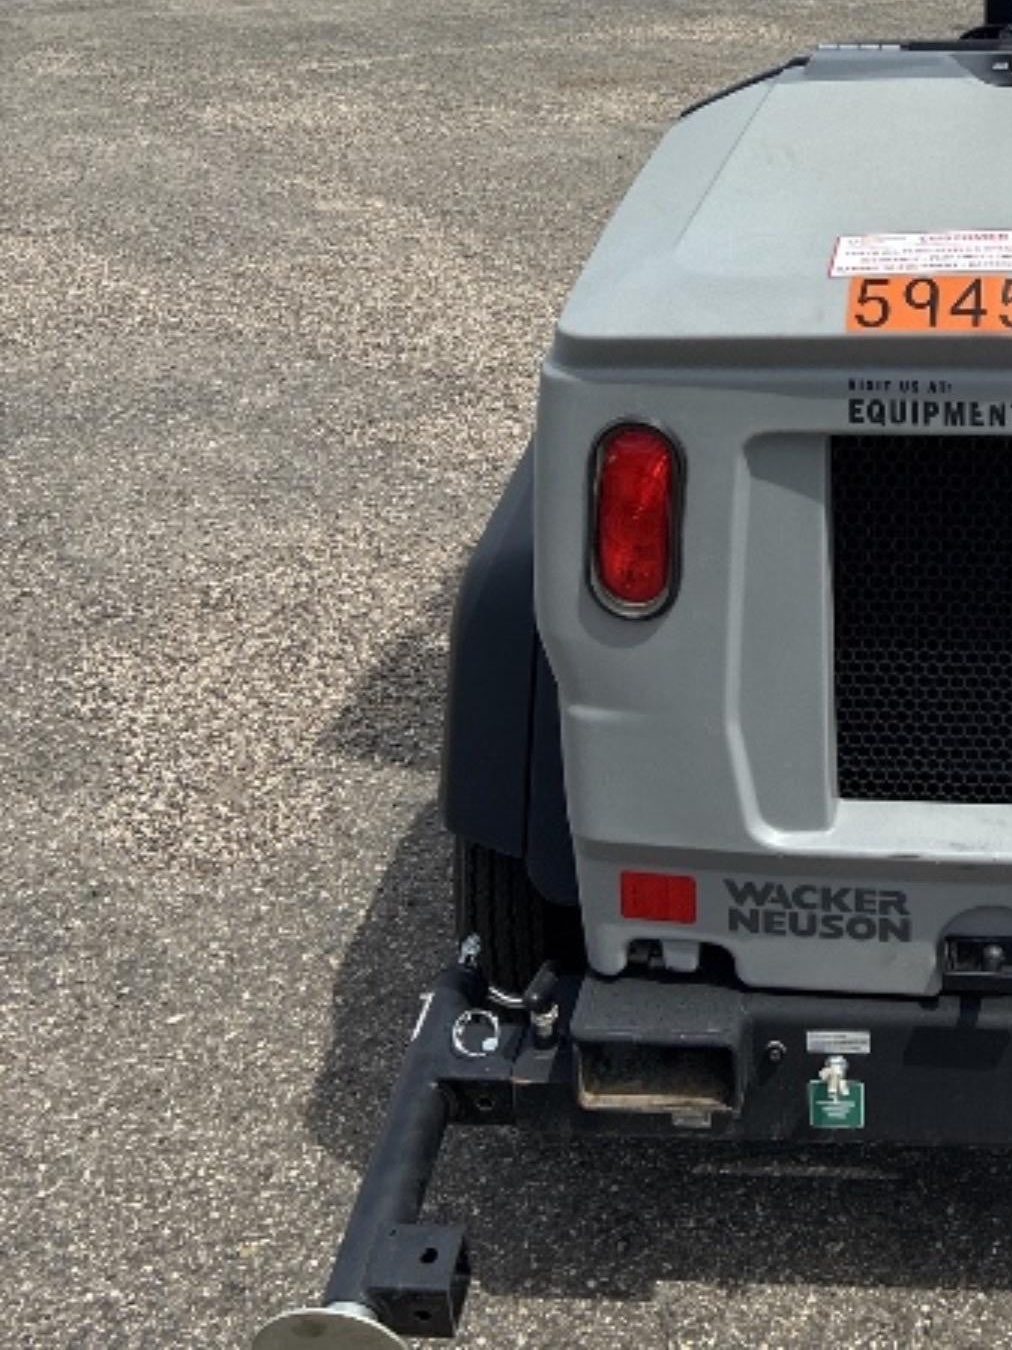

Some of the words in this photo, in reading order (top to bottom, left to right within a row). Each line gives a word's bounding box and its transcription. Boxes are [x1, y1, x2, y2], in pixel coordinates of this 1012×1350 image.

[899, 380, 919, 394] US
[723, 878, 909, 915] WACKER
[728, 906, 912, 943] NEUSON
